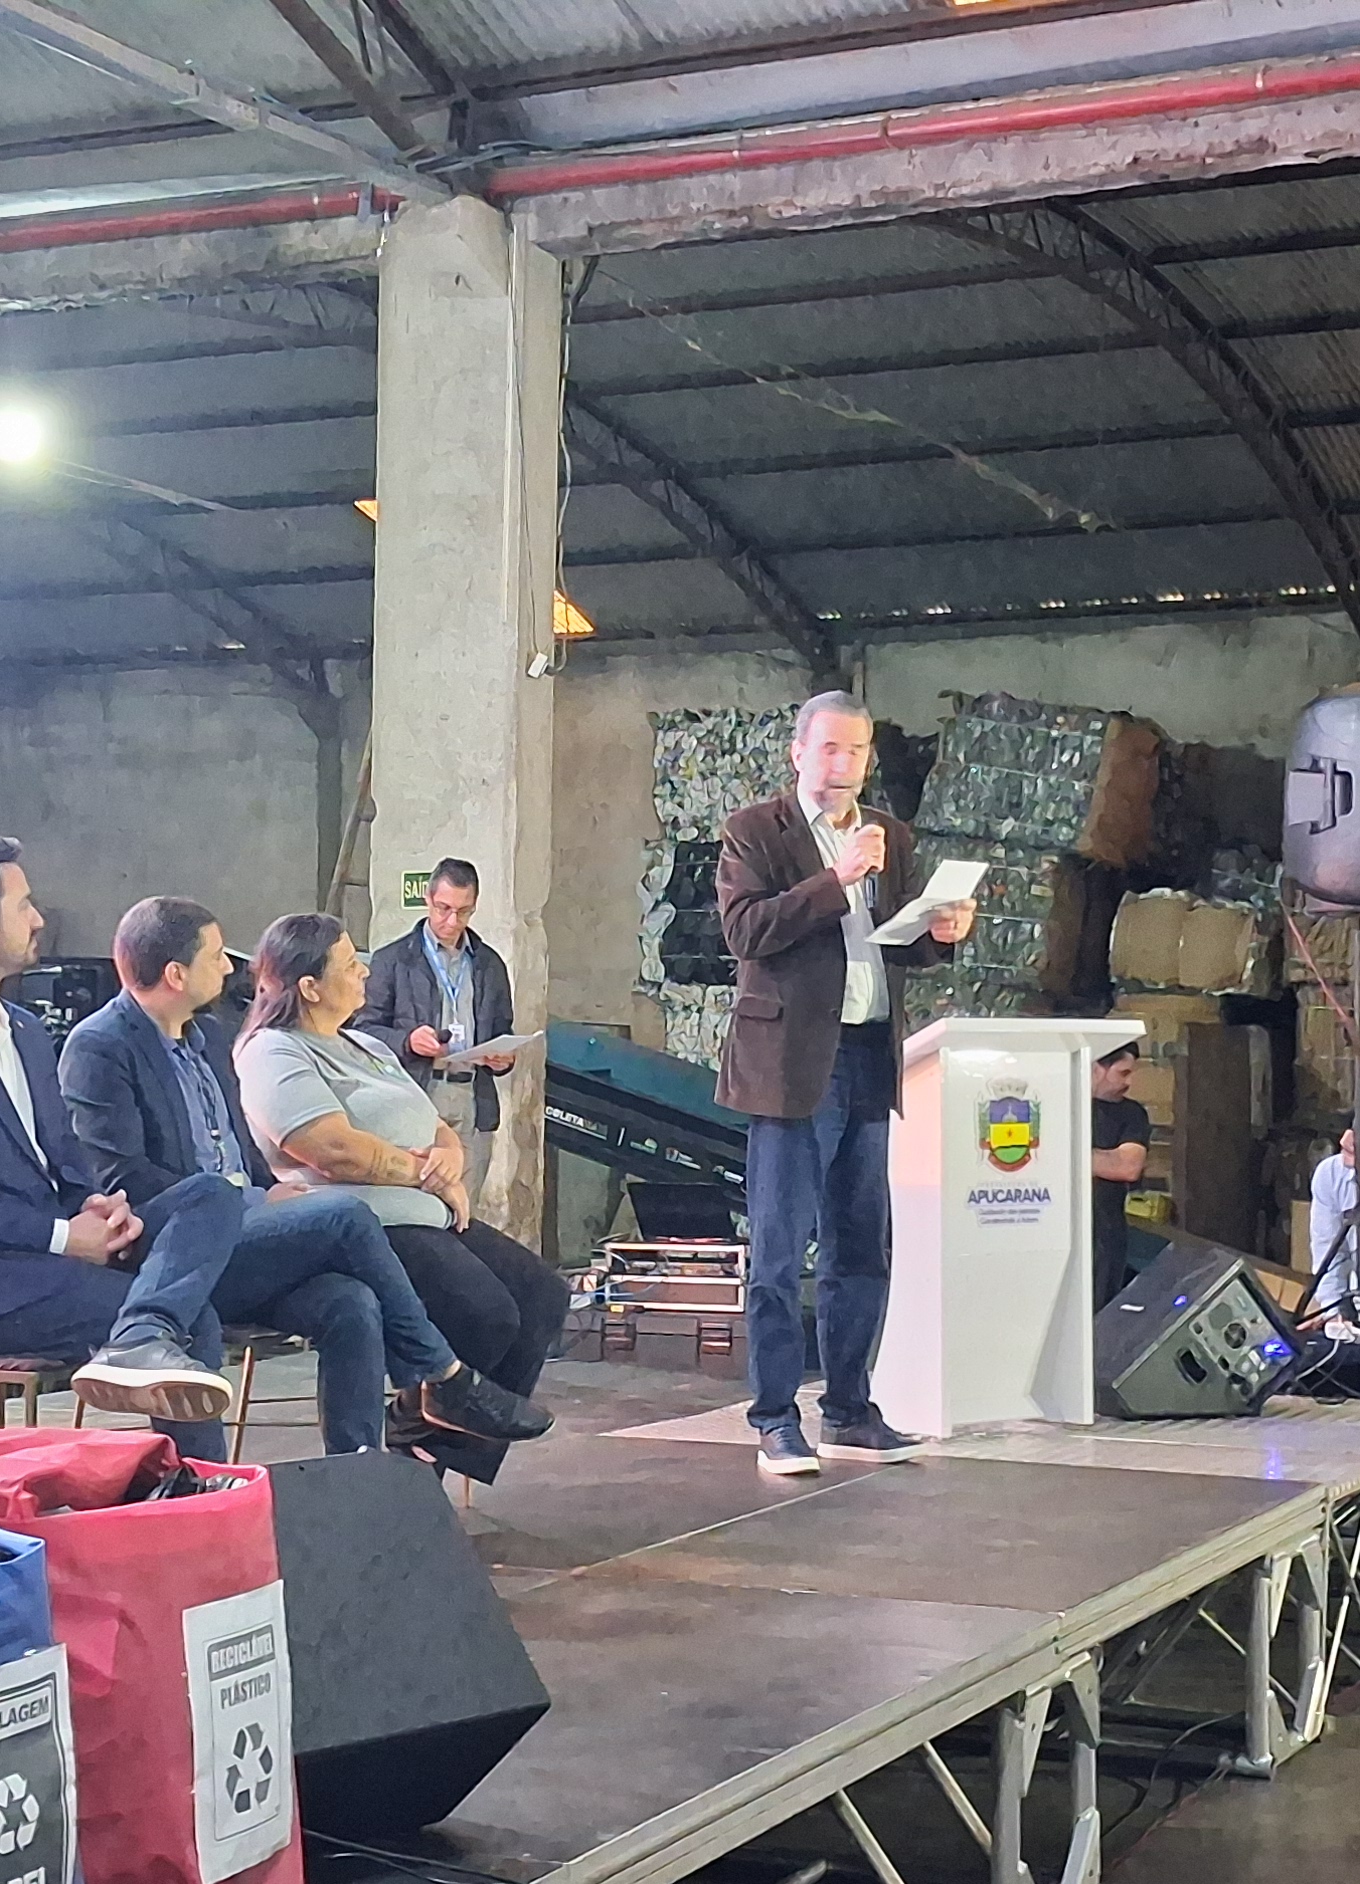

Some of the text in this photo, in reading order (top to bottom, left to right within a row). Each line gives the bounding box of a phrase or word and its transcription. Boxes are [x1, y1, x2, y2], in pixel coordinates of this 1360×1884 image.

[404, 875, 429, 899] SAÍD
[967, 1187, 1052, 1205] APUCARANA
[220, 1672, 272, 1710] PLÁSTICO
